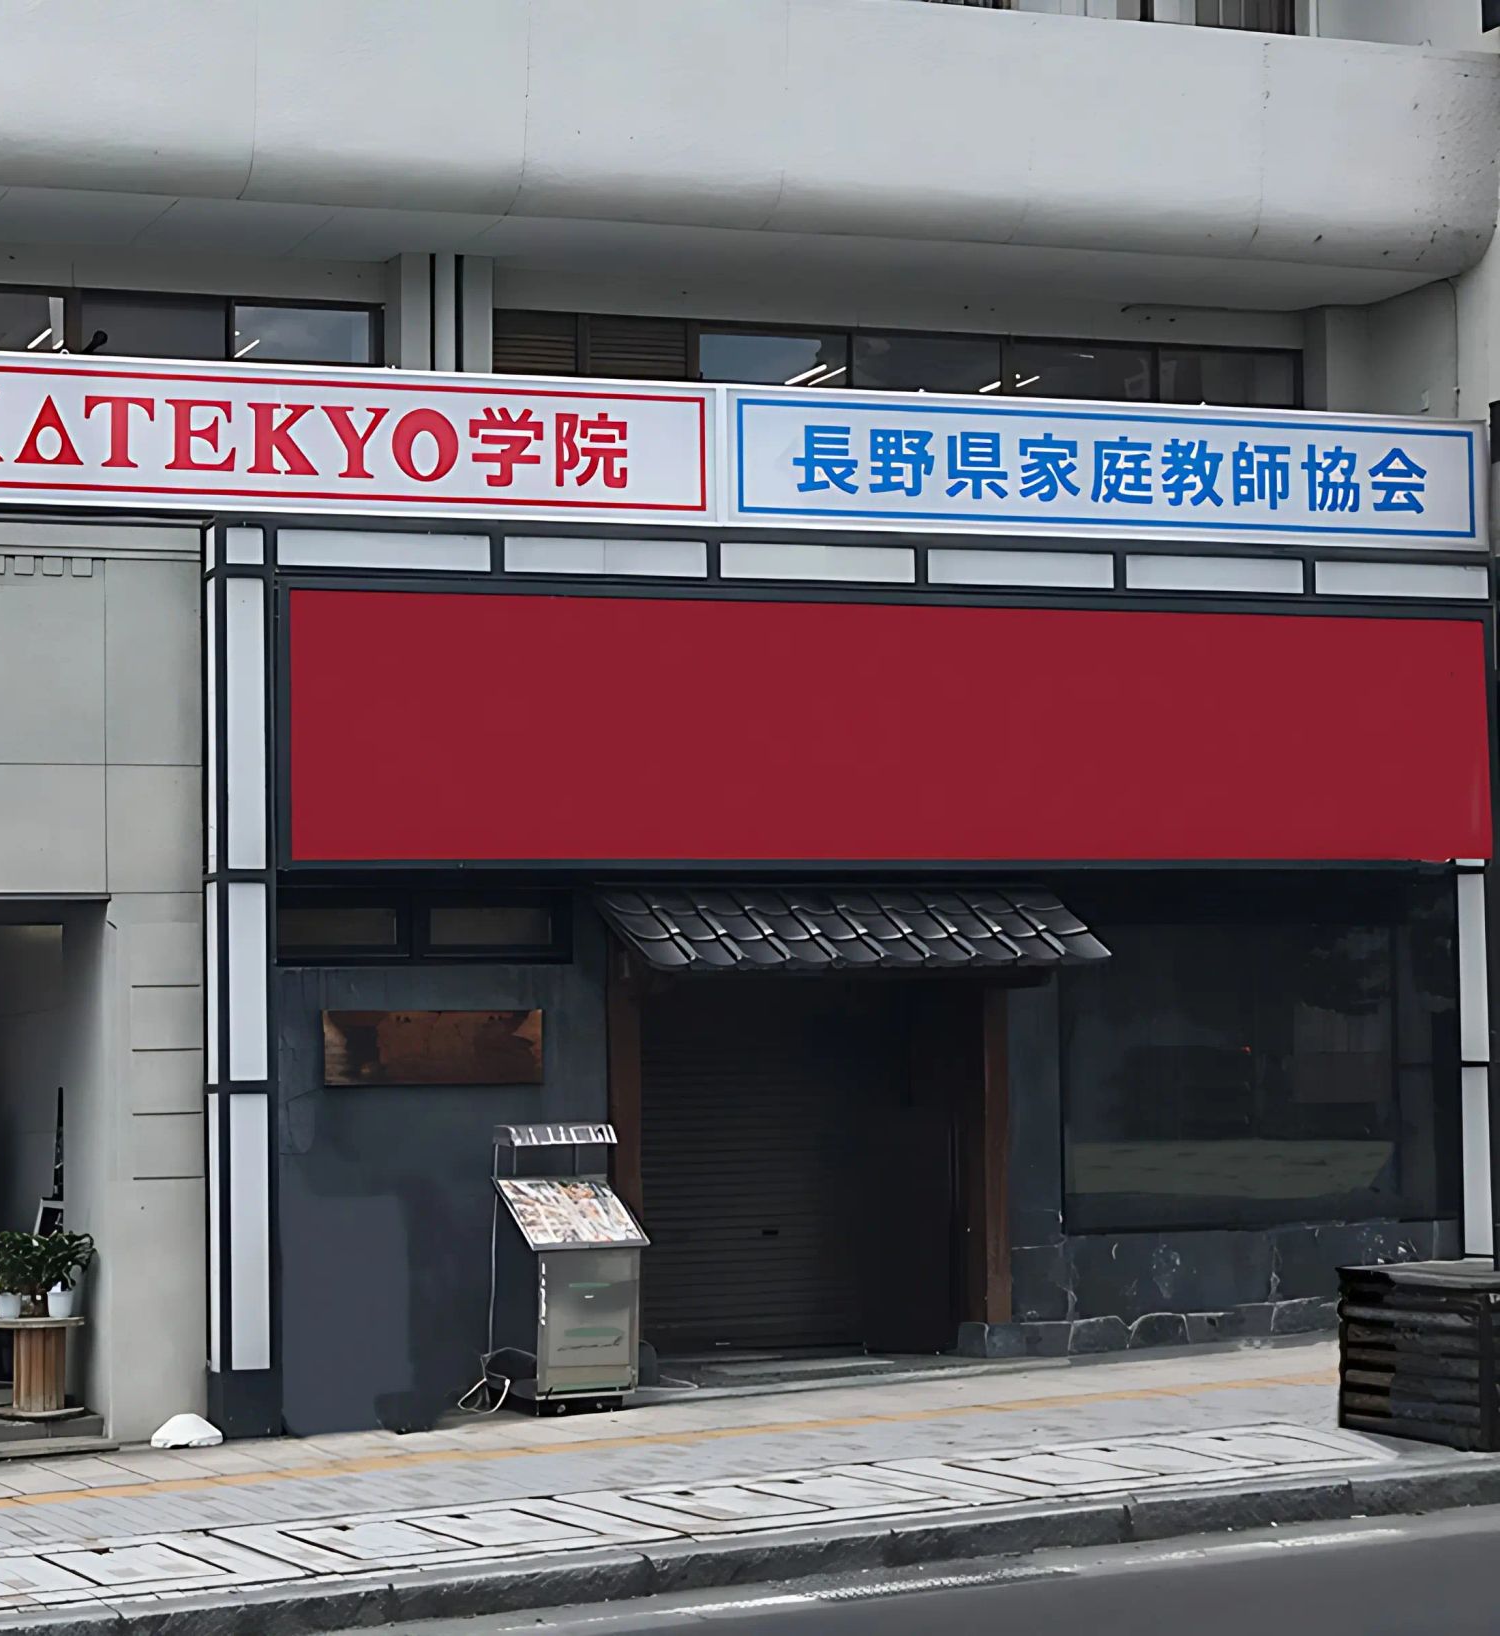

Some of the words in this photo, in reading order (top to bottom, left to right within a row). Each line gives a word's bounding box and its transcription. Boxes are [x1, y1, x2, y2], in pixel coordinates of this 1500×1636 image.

[791, 424, 1427, 514] 長野県家庭教師協会
